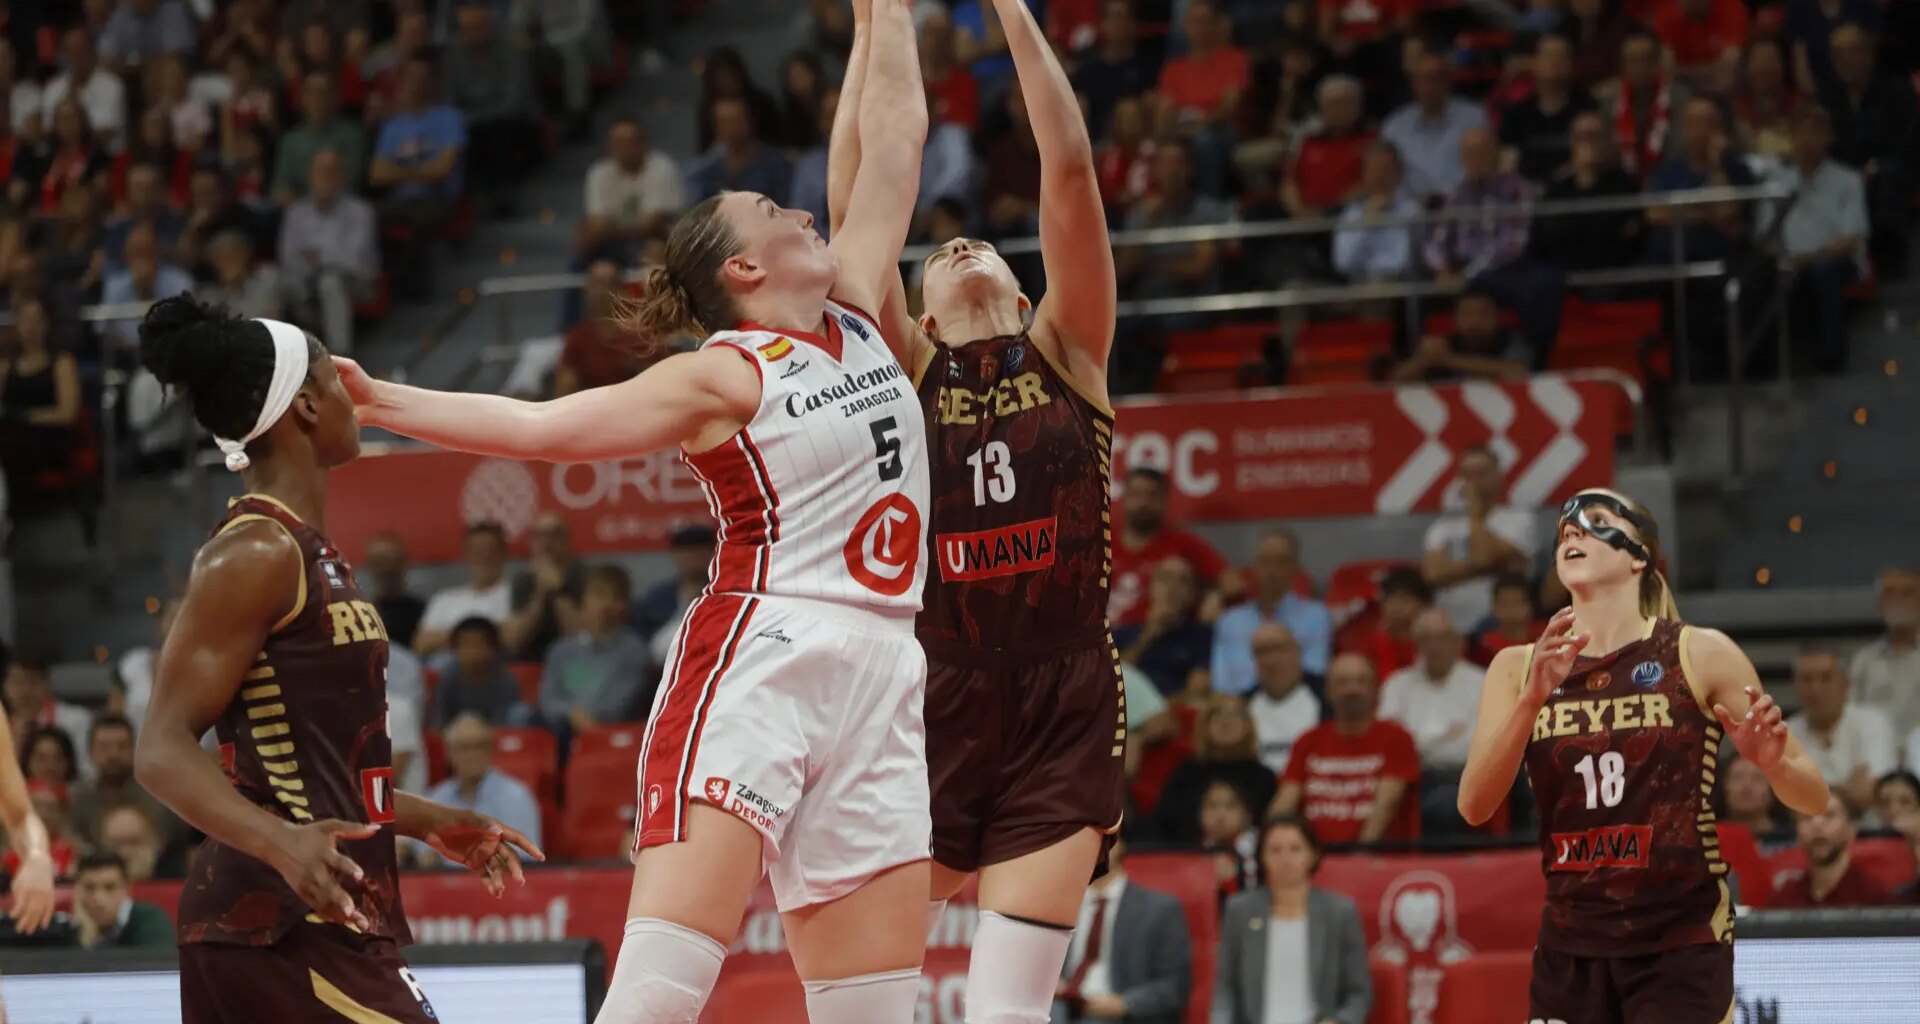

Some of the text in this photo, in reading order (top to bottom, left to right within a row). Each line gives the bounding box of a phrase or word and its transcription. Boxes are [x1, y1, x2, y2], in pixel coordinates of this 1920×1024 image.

[841, 387, 902, 418] ZARAGOZA
[869, 416, 904, 482] 5
[966, 440, 1016, 507] 13
[946, 527, 1052, 574] UMANA
[1532, 693, 1674, 744] REYER
[1574, 750, 1626, 810] 18
